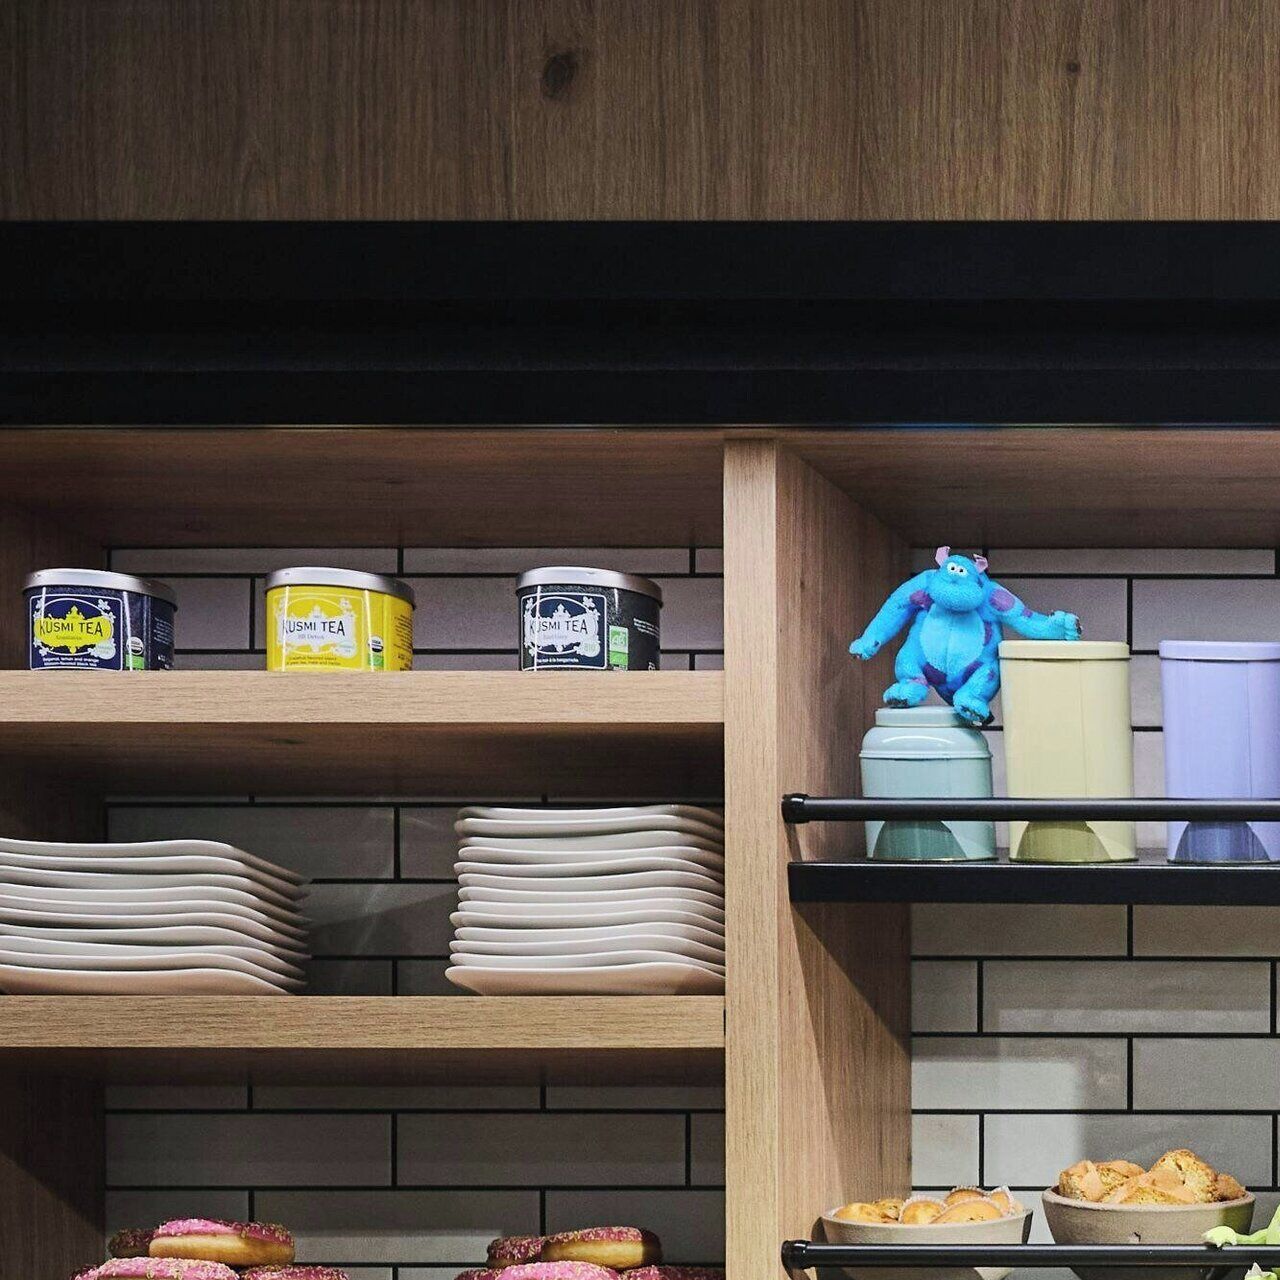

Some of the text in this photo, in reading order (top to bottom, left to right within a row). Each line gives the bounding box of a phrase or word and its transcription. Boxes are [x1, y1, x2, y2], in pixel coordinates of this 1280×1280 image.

[40, 621, 103, 637] KUSMI TEA
[283, 620, 345, 636] KUSMI TEA
[565, 619, 588, 634] TEA
